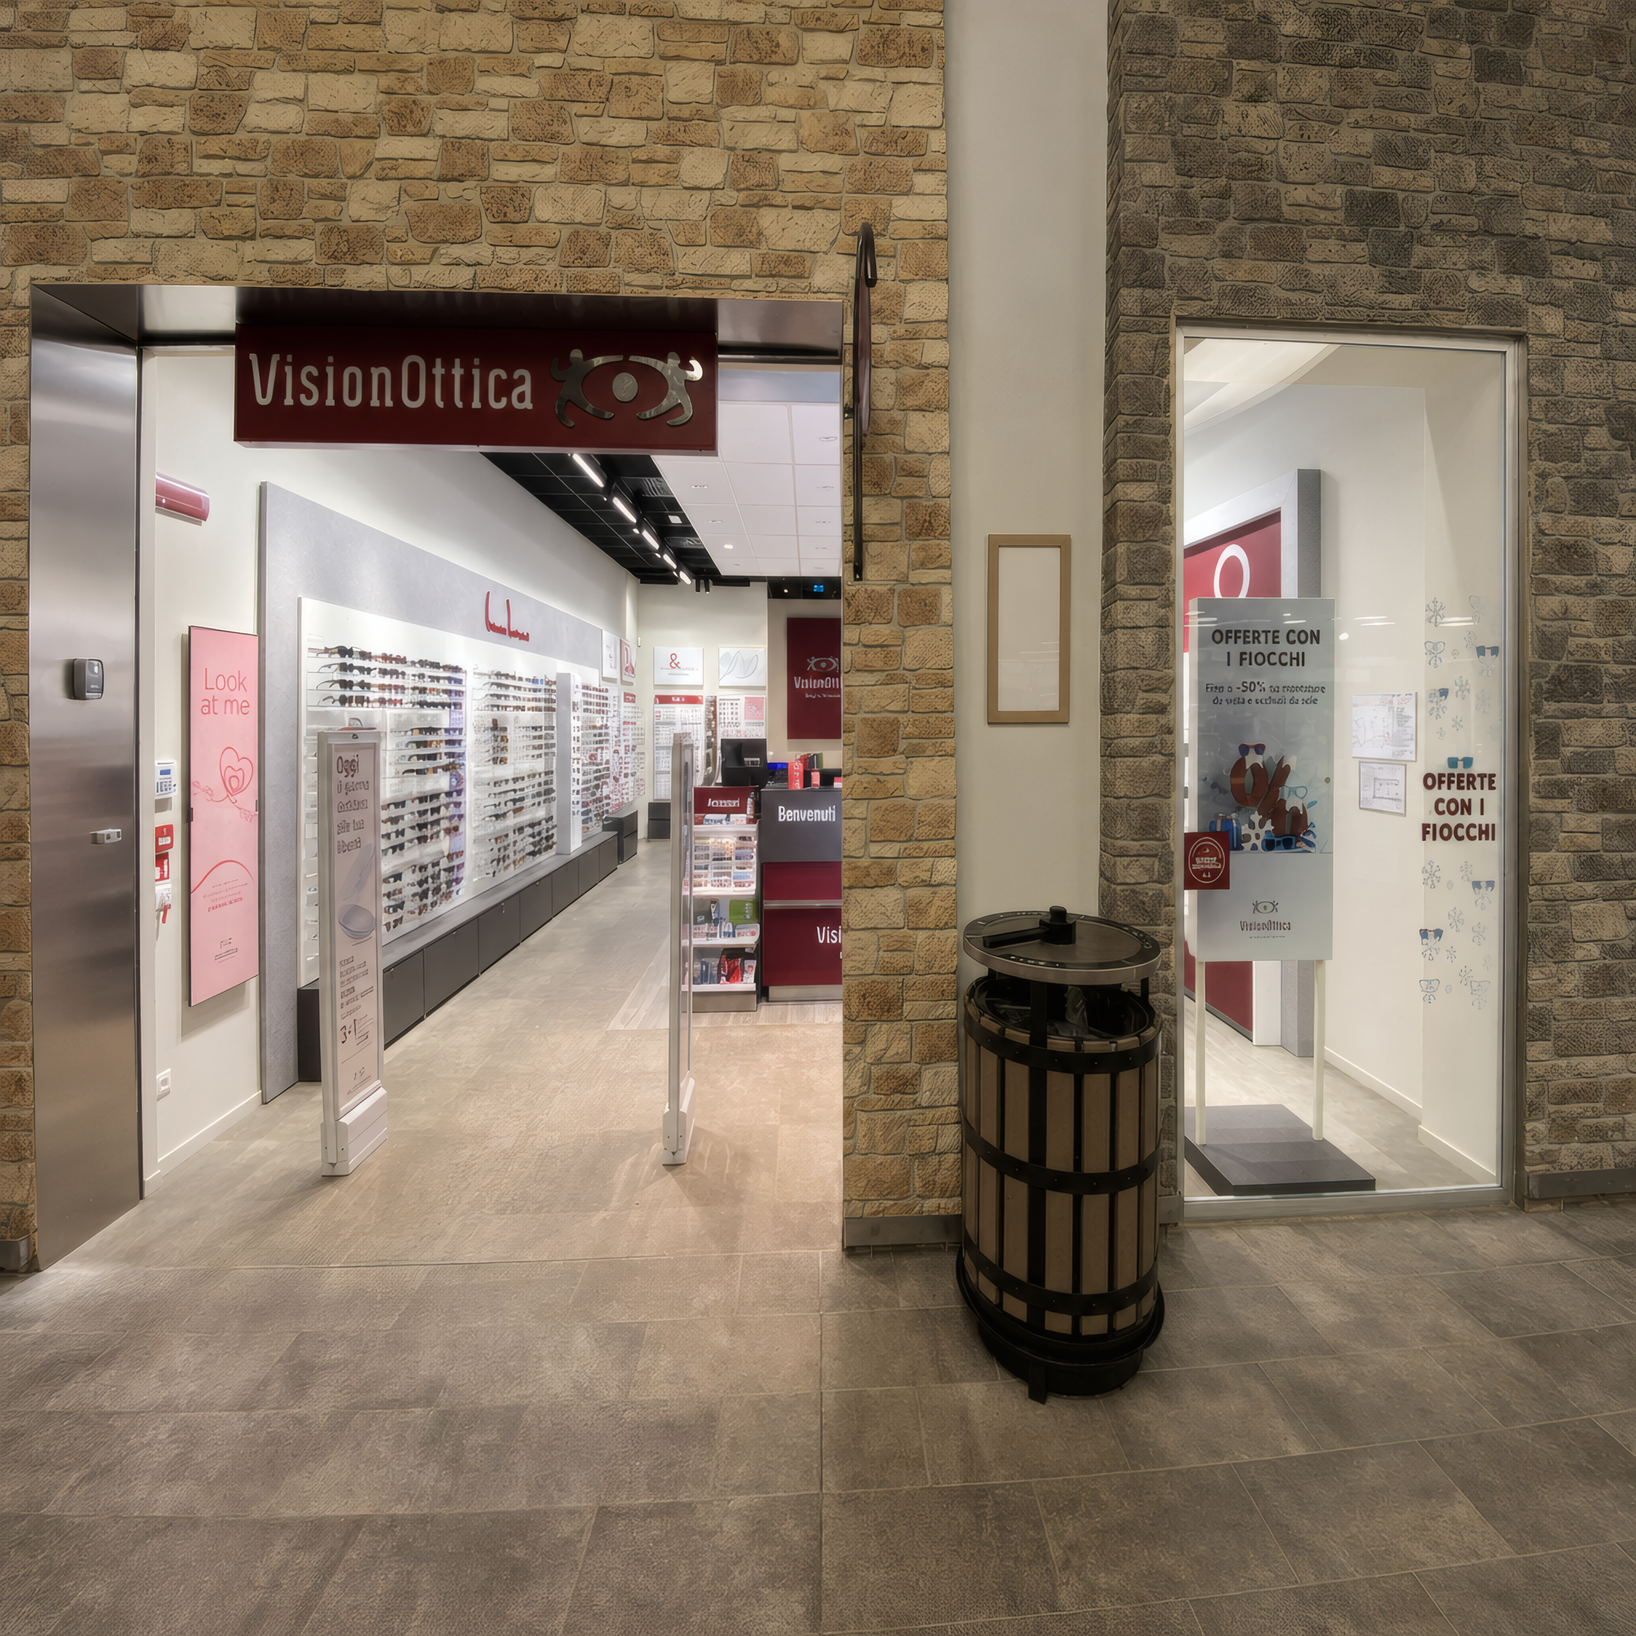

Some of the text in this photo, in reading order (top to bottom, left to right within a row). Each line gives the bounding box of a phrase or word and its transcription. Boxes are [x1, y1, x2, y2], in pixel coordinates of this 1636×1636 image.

[248, 352, 534, 410] VisionOttica
[1211, 628, 1321, 645] OFFERTE CON
[1226, 651, 1305, 667] I FIOCCHI
[203, 667, 248, 693] Look
[200, 694, 250, 716] at me
[1422, 772, 1497, 791] OFFERTE
[777, 804, 837, 823] Benvenuti
[1434, 797, 1485, 816] CON I
[1421, 822, 1496, 842] FIOCCHI
[816, 925, 842, 944] Visi
